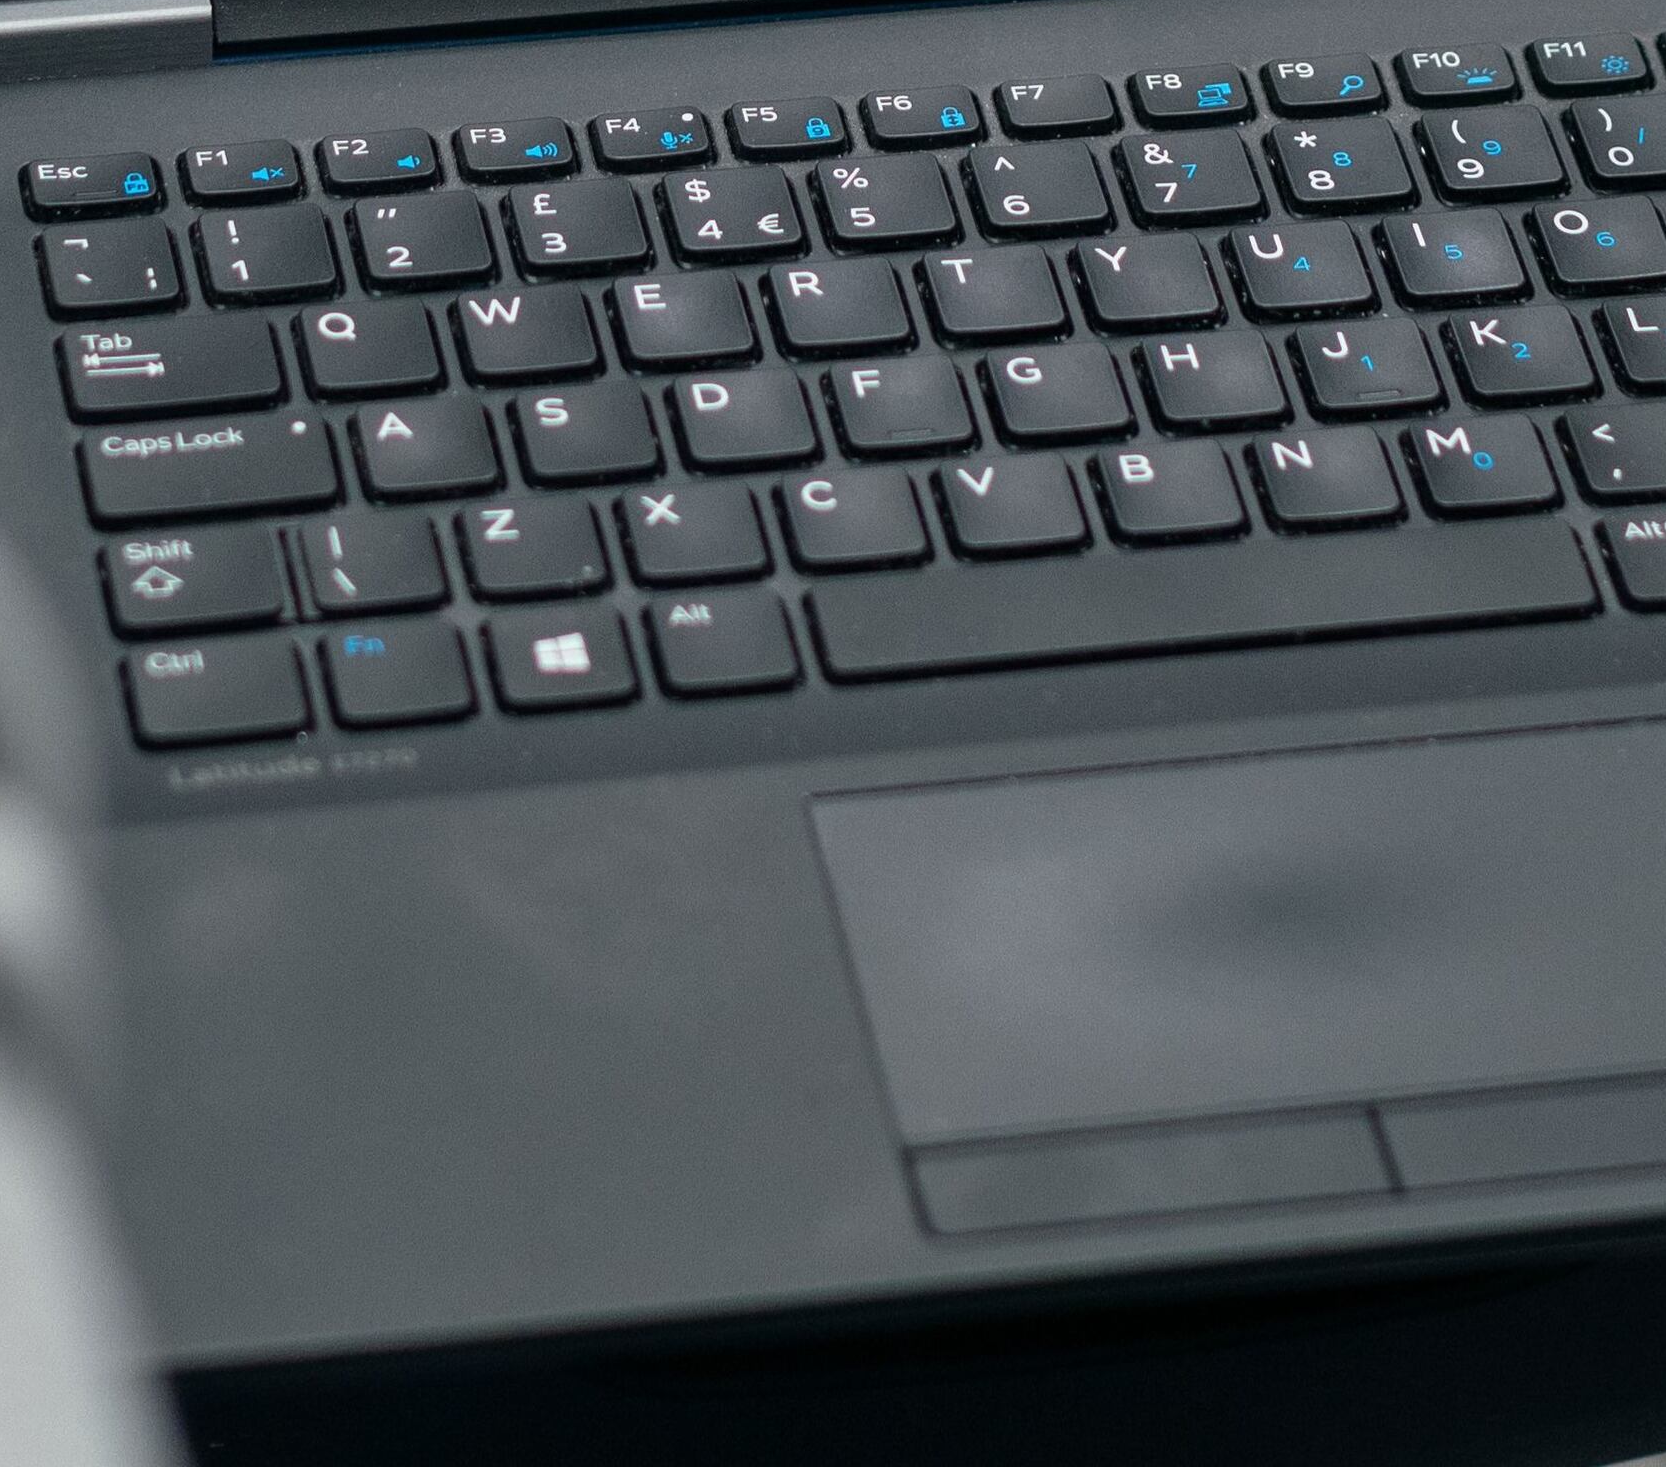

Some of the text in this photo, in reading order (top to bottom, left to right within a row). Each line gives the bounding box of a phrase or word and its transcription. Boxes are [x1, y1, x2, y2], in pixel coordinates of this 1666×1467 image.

[1544, 42, 1586, 58] F11
[1413, 52, 1460, 68] F10
[1278, 63, 1314, 78] F9
[1146, 74, 1181, 89] F8
[1011, 85, 1043, 100] F7
[876, 96, 912, 111] F6
[742, 107, 777, 122] F5
[606, 118, 640, 133] F4
[470, 128, 506, 143] F3
[333, 139, 368, 155] F2
[196, 150, 227, 166] F1
[38, 165, 87, 179] Esc
[1095, 247, 1126, 271] Y
[789, 272, 823, 296] R
[469, 297, 520, 324] W
[319, 313, 355, 340] Q
[81, 334, 132, 350] Tab
[1007, 357, 1042, 383] G
[692, 383, 728, 410] D
[378, 413, 413, 439] A
[101, 427, 243, 459] Caps Lock
[1426, 428, 1471, 454] M
[642, 495, 679, 523] X
[126, 541, 192, 562] Shift
[671, 604, 711, 623] Alt
[344, 635, 385, 654] Fn
[146, 650, 203, 672] Ctrl
